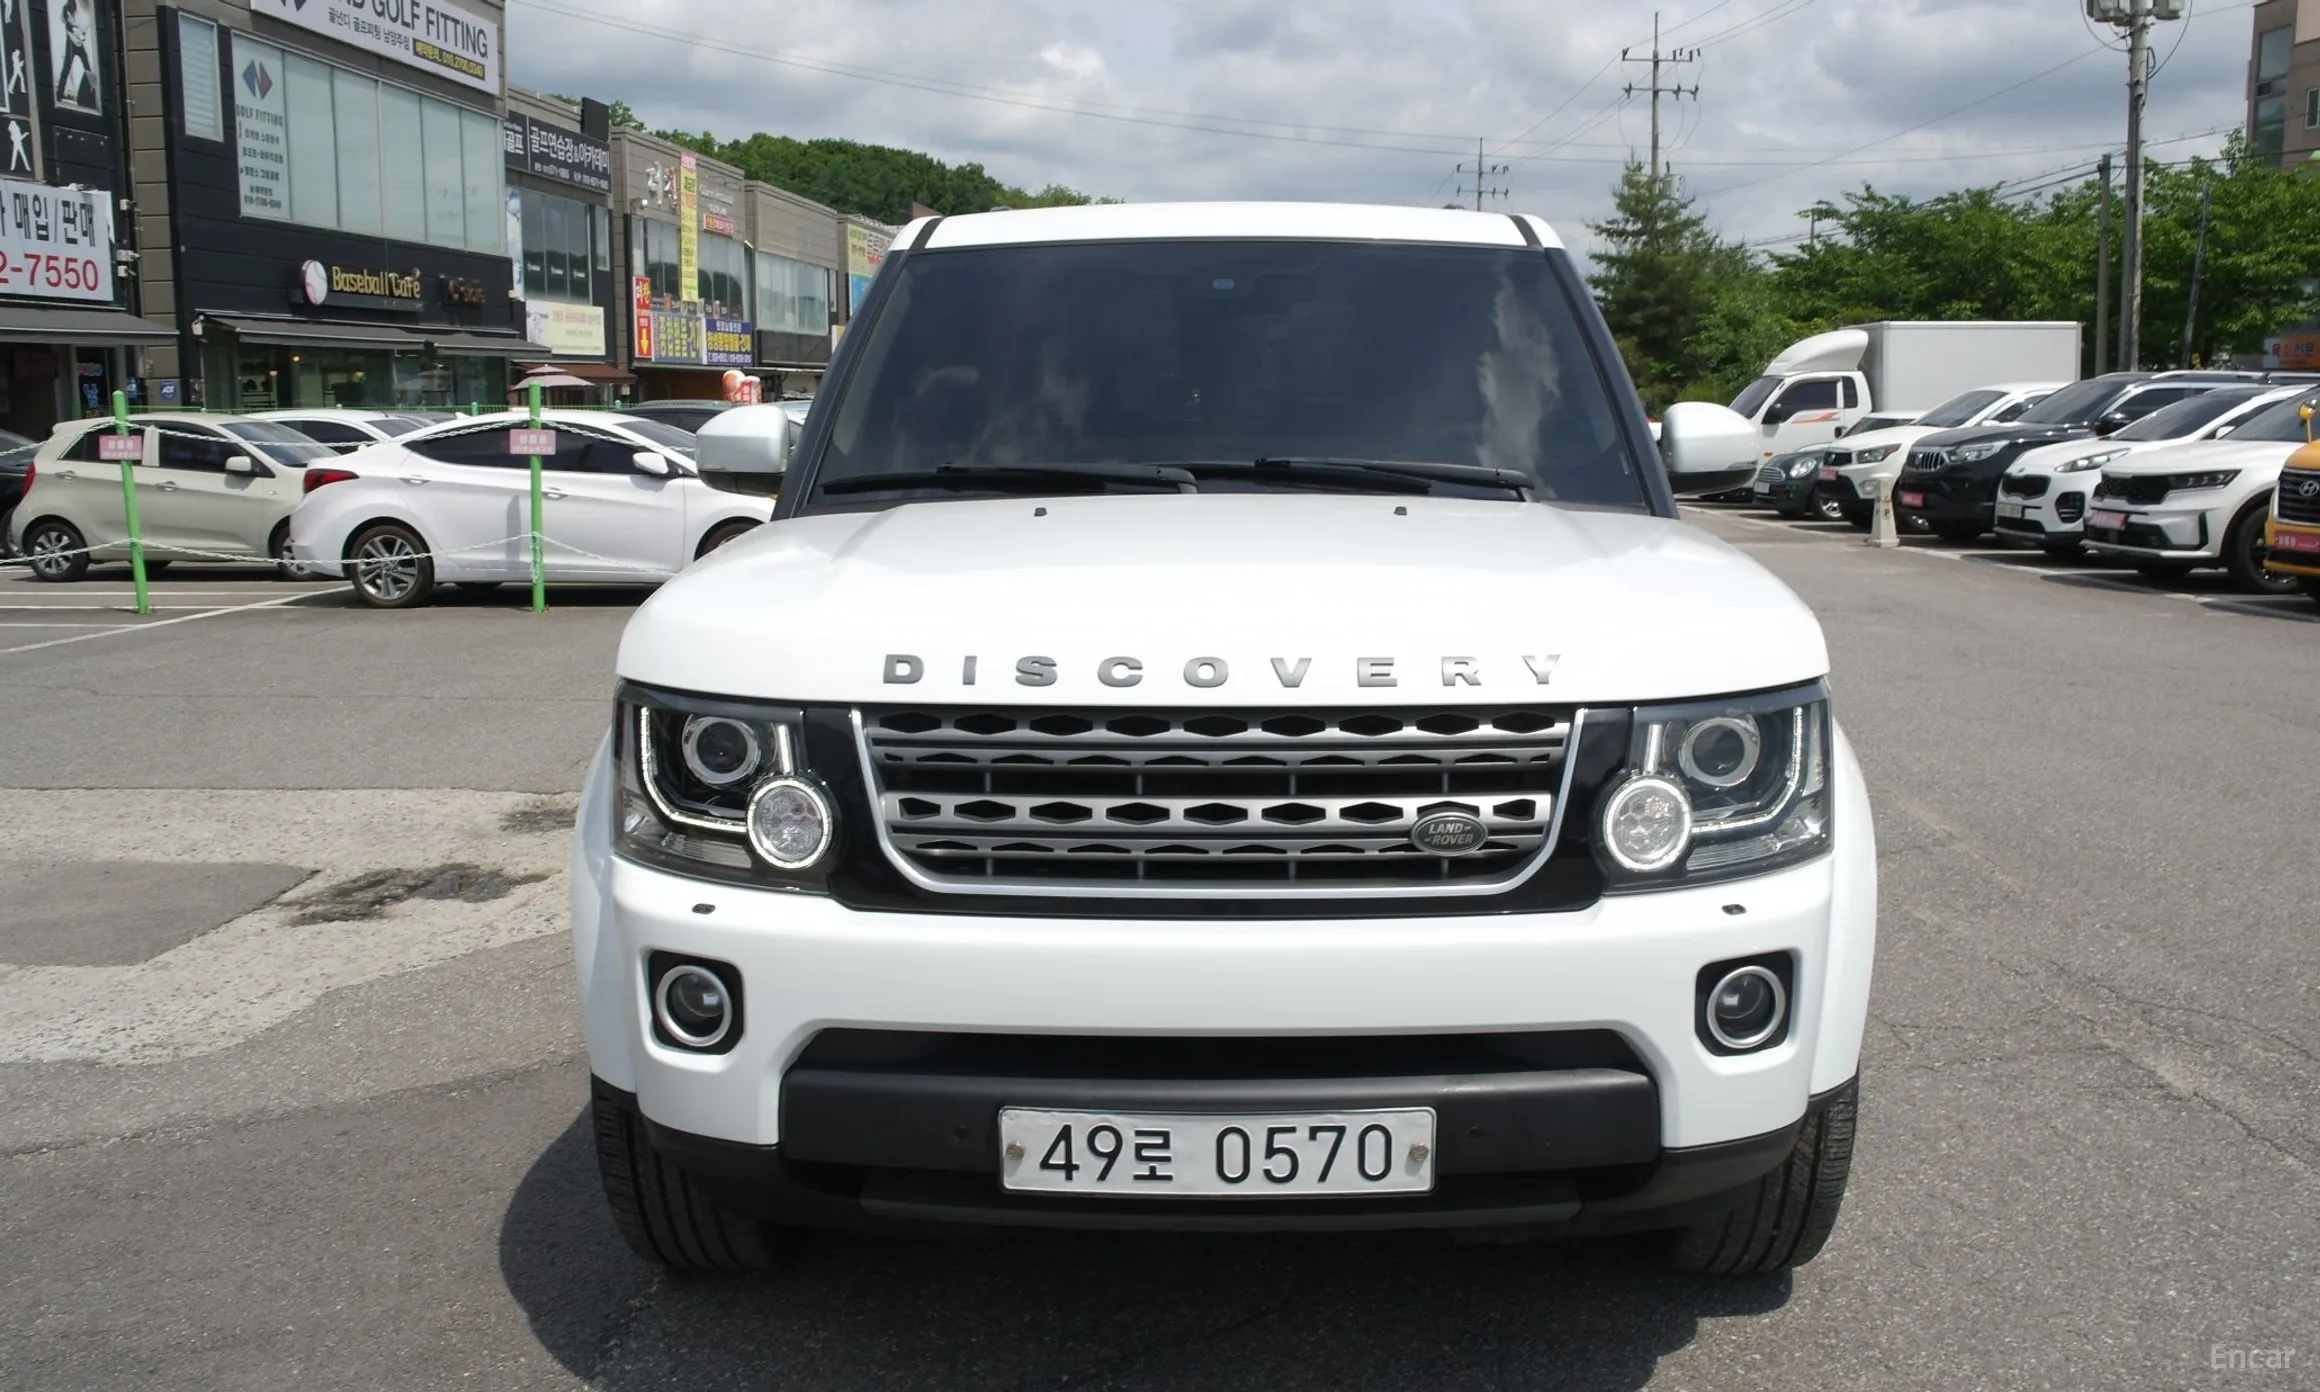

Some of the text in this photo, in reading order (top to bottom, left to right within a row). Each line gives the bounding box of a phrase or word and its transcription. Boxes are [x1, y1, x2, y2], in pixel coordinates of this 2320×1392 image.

[372, 0, 488, 59] GOLF FITTING
[502, 130, 524, 155] 골프
[530, 125, 610, 175] 골프연습장&아카데미
[13, 192, 96, 247] 매입/판매
[332, 265, 388, 297] Baseball
[883, 654, 1561, 687] DISCOVERY
[1428, 823, 1463, 834] LAND
[1432, 833, 1474, 845] ROVER
[1039, 1123, 1393, 1183] 49로 0570
